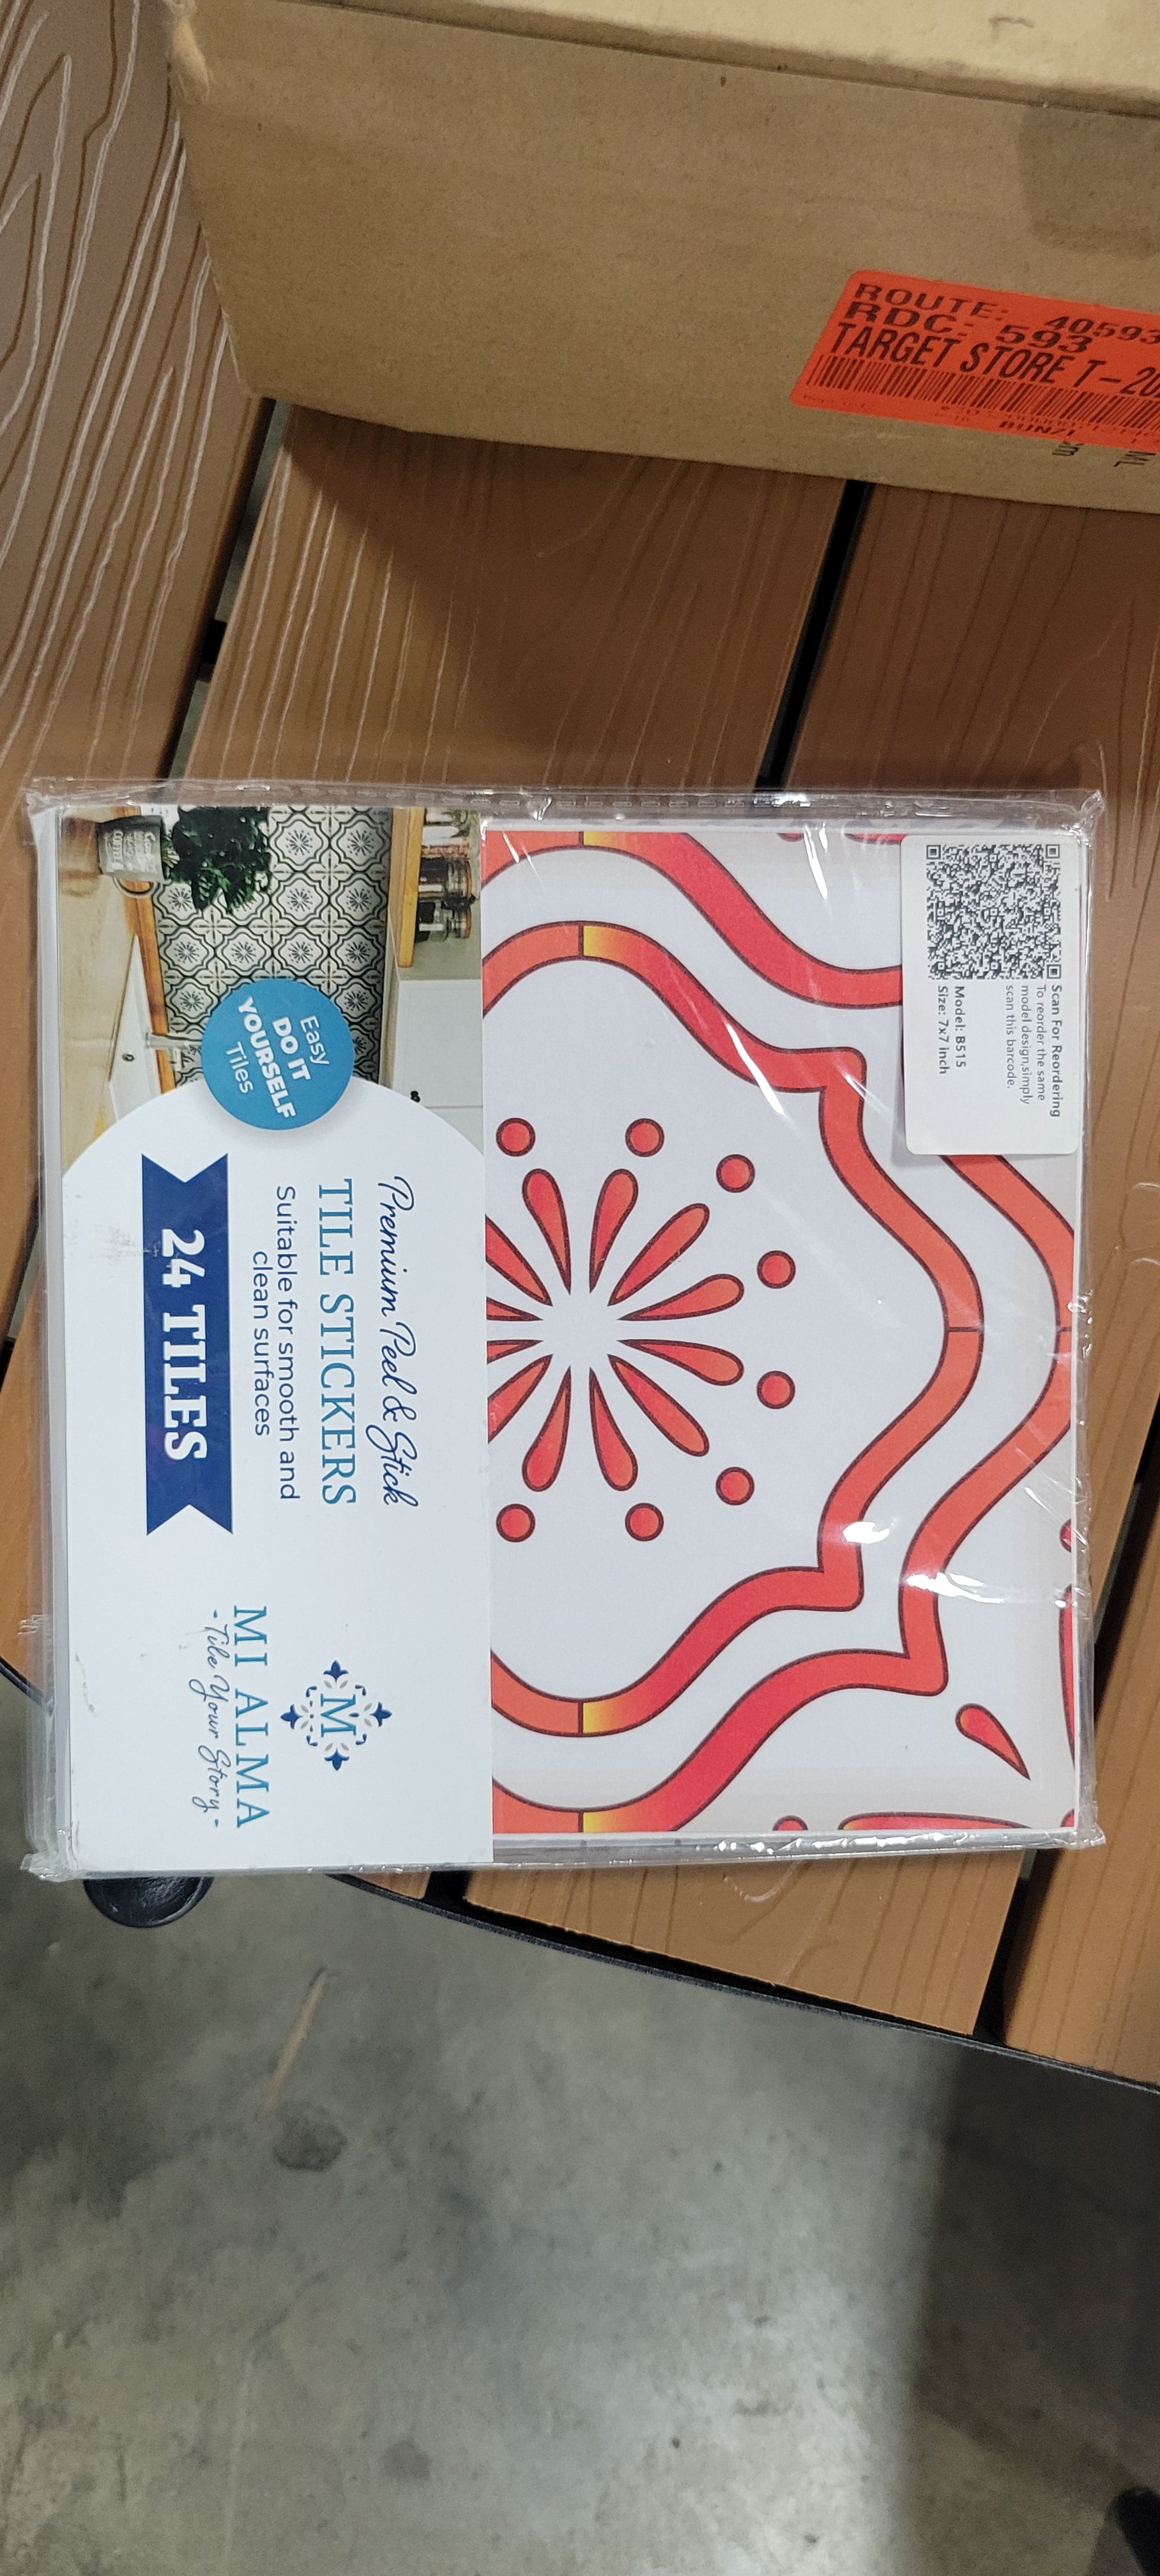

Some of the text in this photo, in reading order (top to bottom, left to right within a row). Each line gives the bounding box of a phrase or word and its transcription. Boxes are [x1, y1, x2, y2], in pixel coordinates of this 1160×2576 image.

[844, 302, 1092, 353] RDC: 593
[854, 284, 1009, 320] ROUTE:
[830, 323, 961, 368] TARGET
[959, 342, 1075, 384] STORE
[300, 1015, 330, 1066] Easy
[938, 986, 950, 1075] Size: 7x7 inch
[954, 986, 966, 1068] Model: B515
[1006, 1014, 1016, 1035] this
[1021, 985, 1032, 1025] model
[226, 1042, 253, 1093] Tiles
[238, 996, 296, 1119] YOURSELF
[273, 1016, 310, 1080] DO IT
[1006, 1038, 1016, 1089] barcode.
[1037, 985, 1047, 1101] To reorder the same
[1049, 985, 1062, 1117] Scan For Reordering
[161, 1229, 208, 1460] 24 TILES
[253, 1251, 275, 1437] clean surfaces
[277, 1186, 301, 1499] Suitable for smooth and
[319, 1178, 357, 1505] TILE STICKERS
[366, 1176, 419, 1507] Premium Peel & Stick
[188, 1675, 230, 1739] Your
[234, 1606, 270, 1828] MI ALMA
[320, 1694, 356, 1737] M
